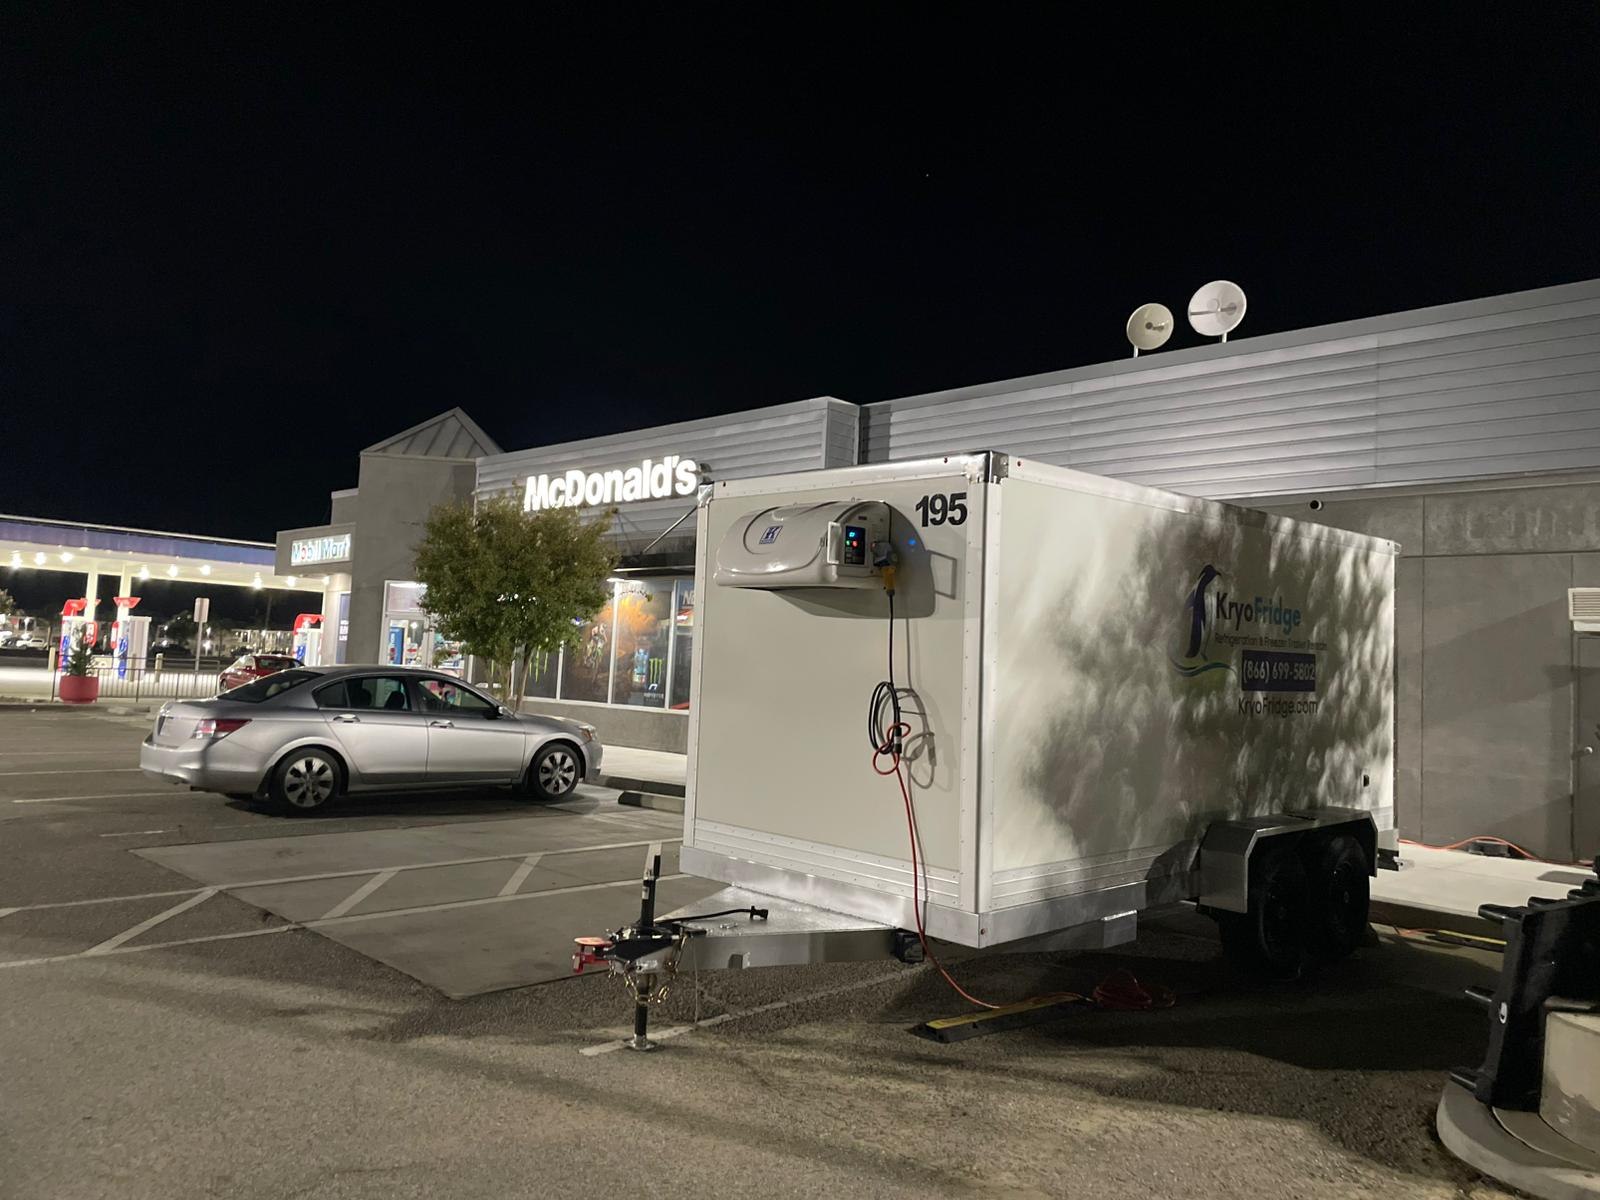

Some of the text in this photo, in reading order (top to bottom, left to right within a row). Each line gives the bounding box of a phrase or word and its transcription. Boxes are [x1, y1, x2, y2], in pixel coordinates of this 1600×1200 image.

[524, 455, 697, 512] McDonald's
[915, 492, 968, 527] 195
[292, 538, 348, 560] Mobil Mart
[1216, 592, 1302, 635] KryoFridge
[1243, 660, 1316, 684] (866) 699-5802
[1239, 697, 1319, 718] KryoFridge.com
